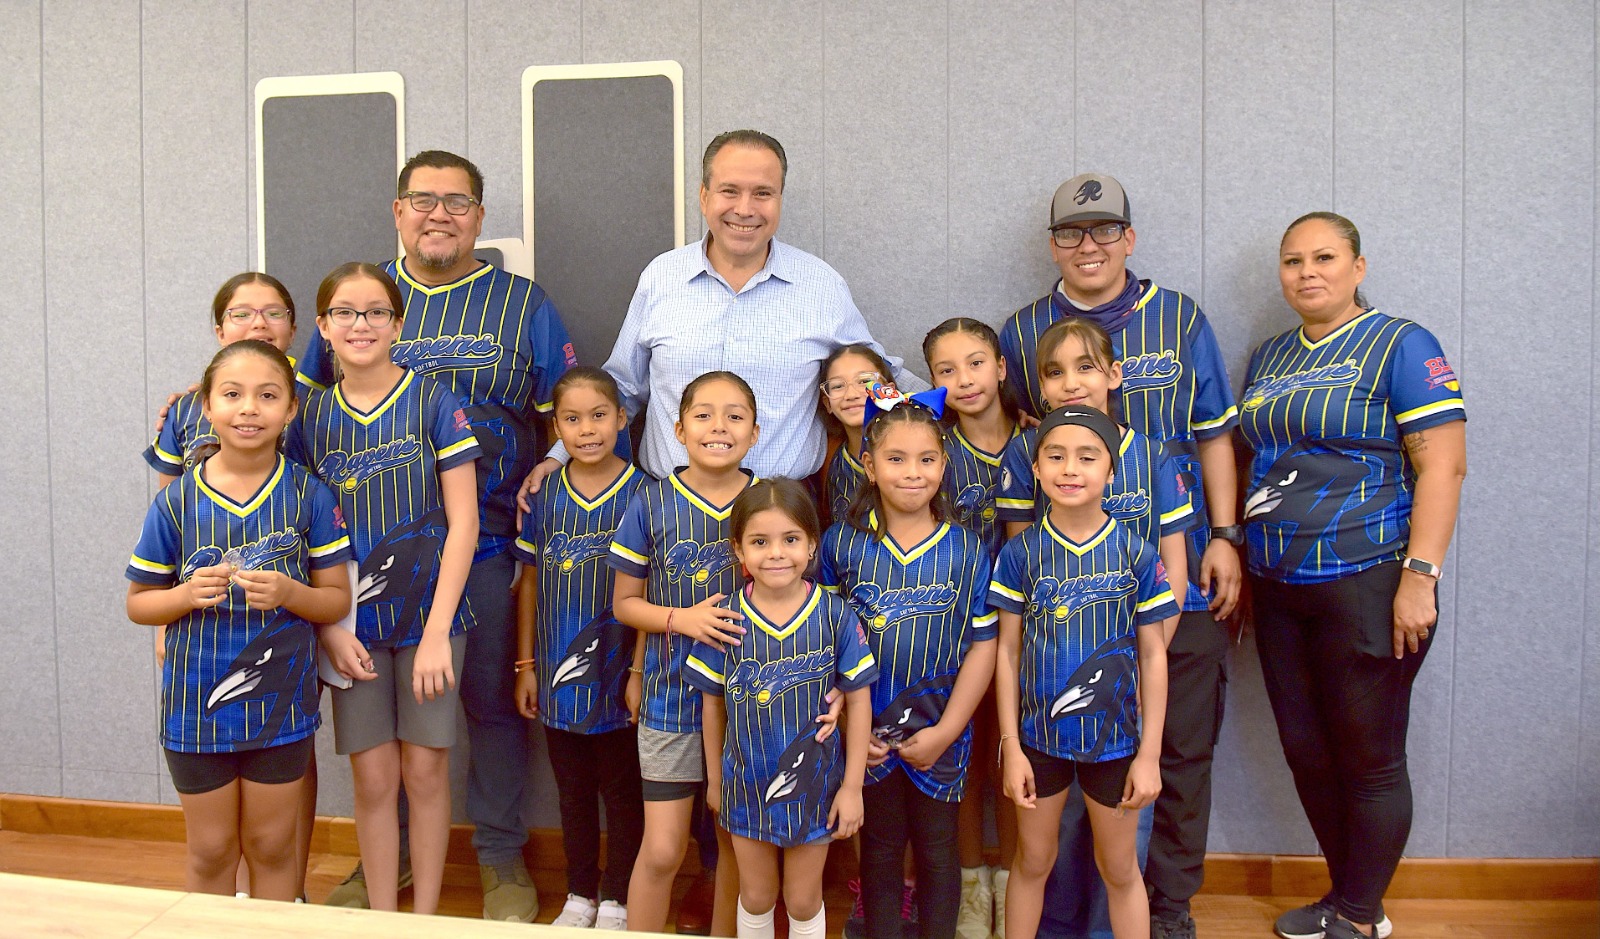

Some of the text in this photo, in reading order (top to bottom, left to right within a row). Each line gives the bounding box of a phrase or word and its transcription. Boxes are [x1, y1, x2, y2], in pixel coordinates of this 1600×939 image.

[390, 333, 503, 366] avens
[414, 359, 439, 372] SOFTBOL
[1121, 349, 1182, 379] ens
[1244, 358, 1362, 405] Ravens
[316, 434, 422, 486] Ravens
[848, 581, 957, 620] Ravens
[1029, 569, 1139, 619] Ravens
[727, 646, 834, 703] Ravens
